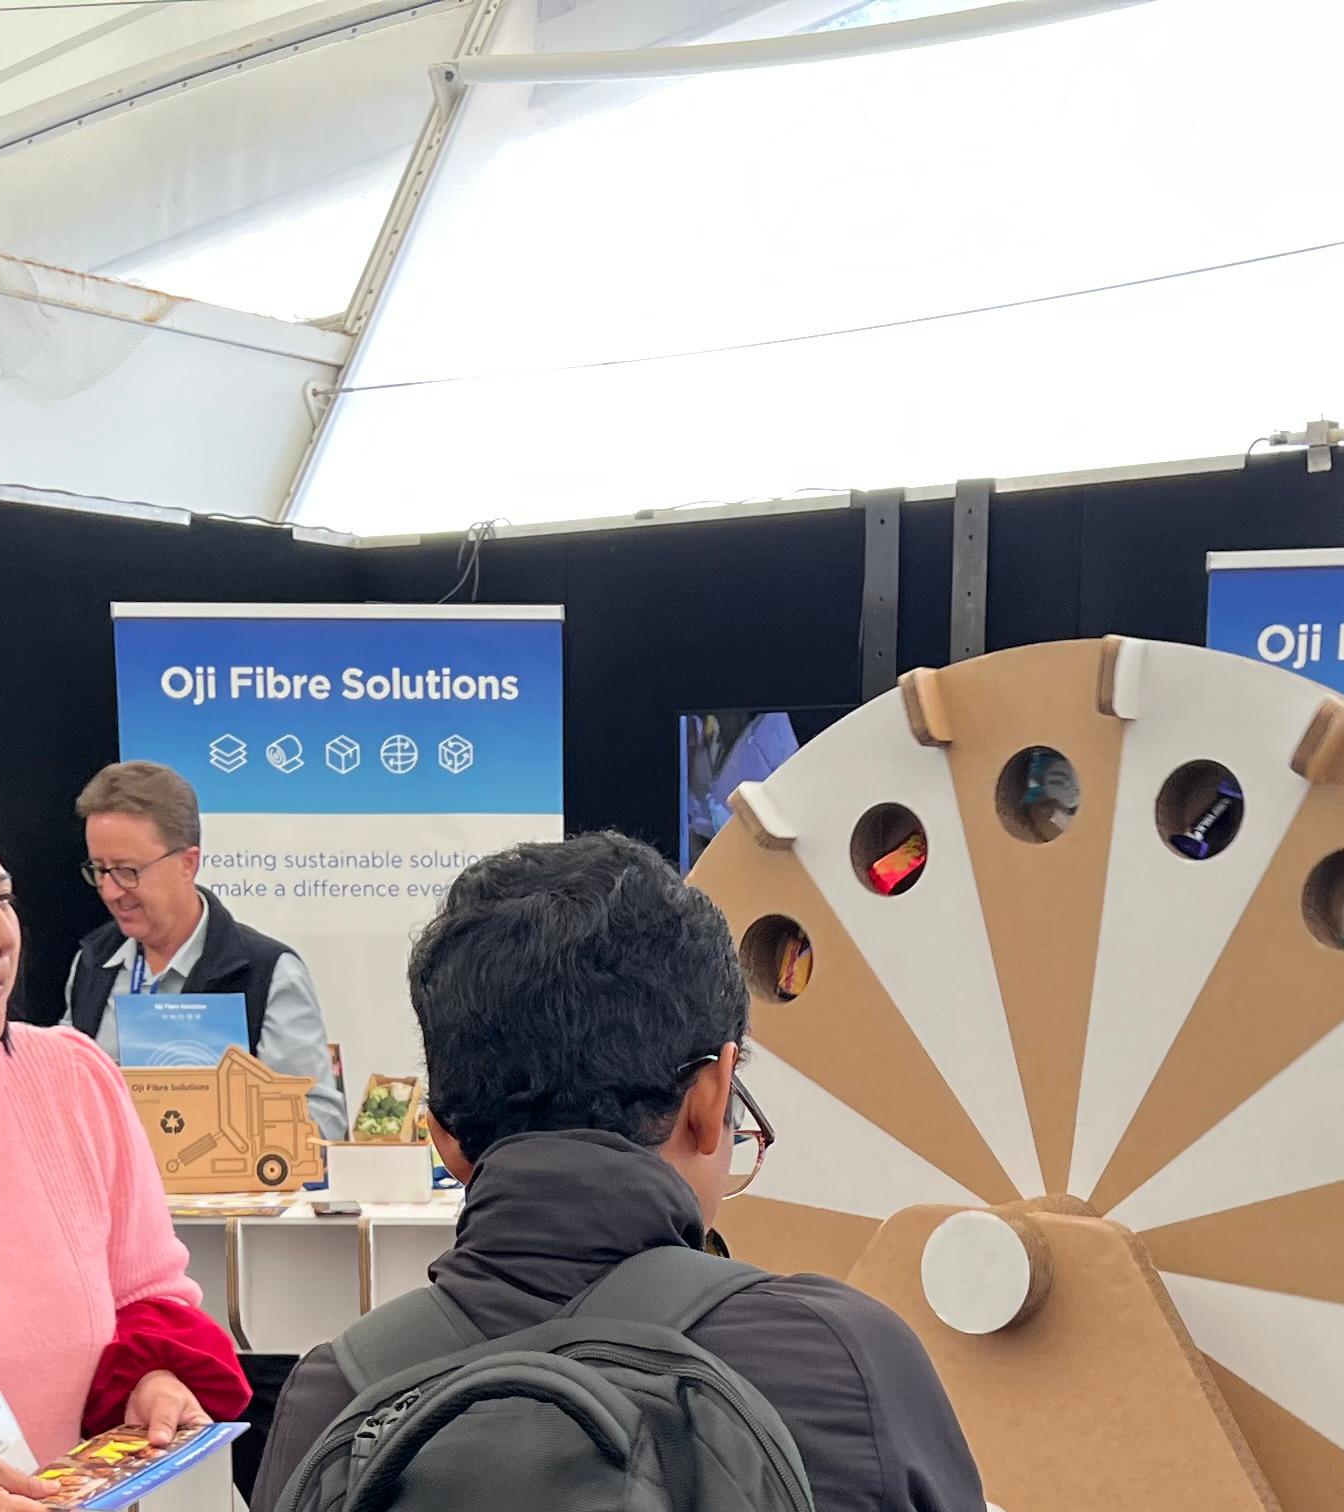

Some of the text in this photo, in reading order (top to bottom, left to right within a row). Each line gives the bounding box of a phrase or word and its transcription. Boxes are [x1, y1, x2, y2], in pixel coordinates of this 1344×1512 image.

[1257, 623, 1322, 669] Oji
[160, 666, 519, 705] Oji Fibre Solutions
[202, 850, 276, 871] reating
[284, 850, 403, 869] sustainable
[211, 879, 269, 897] make
[274, 884, 286, 897] a
[293, 879, 400, 897] difference
[131, 1082, 210, 1093] Oji Fibre Solutions
